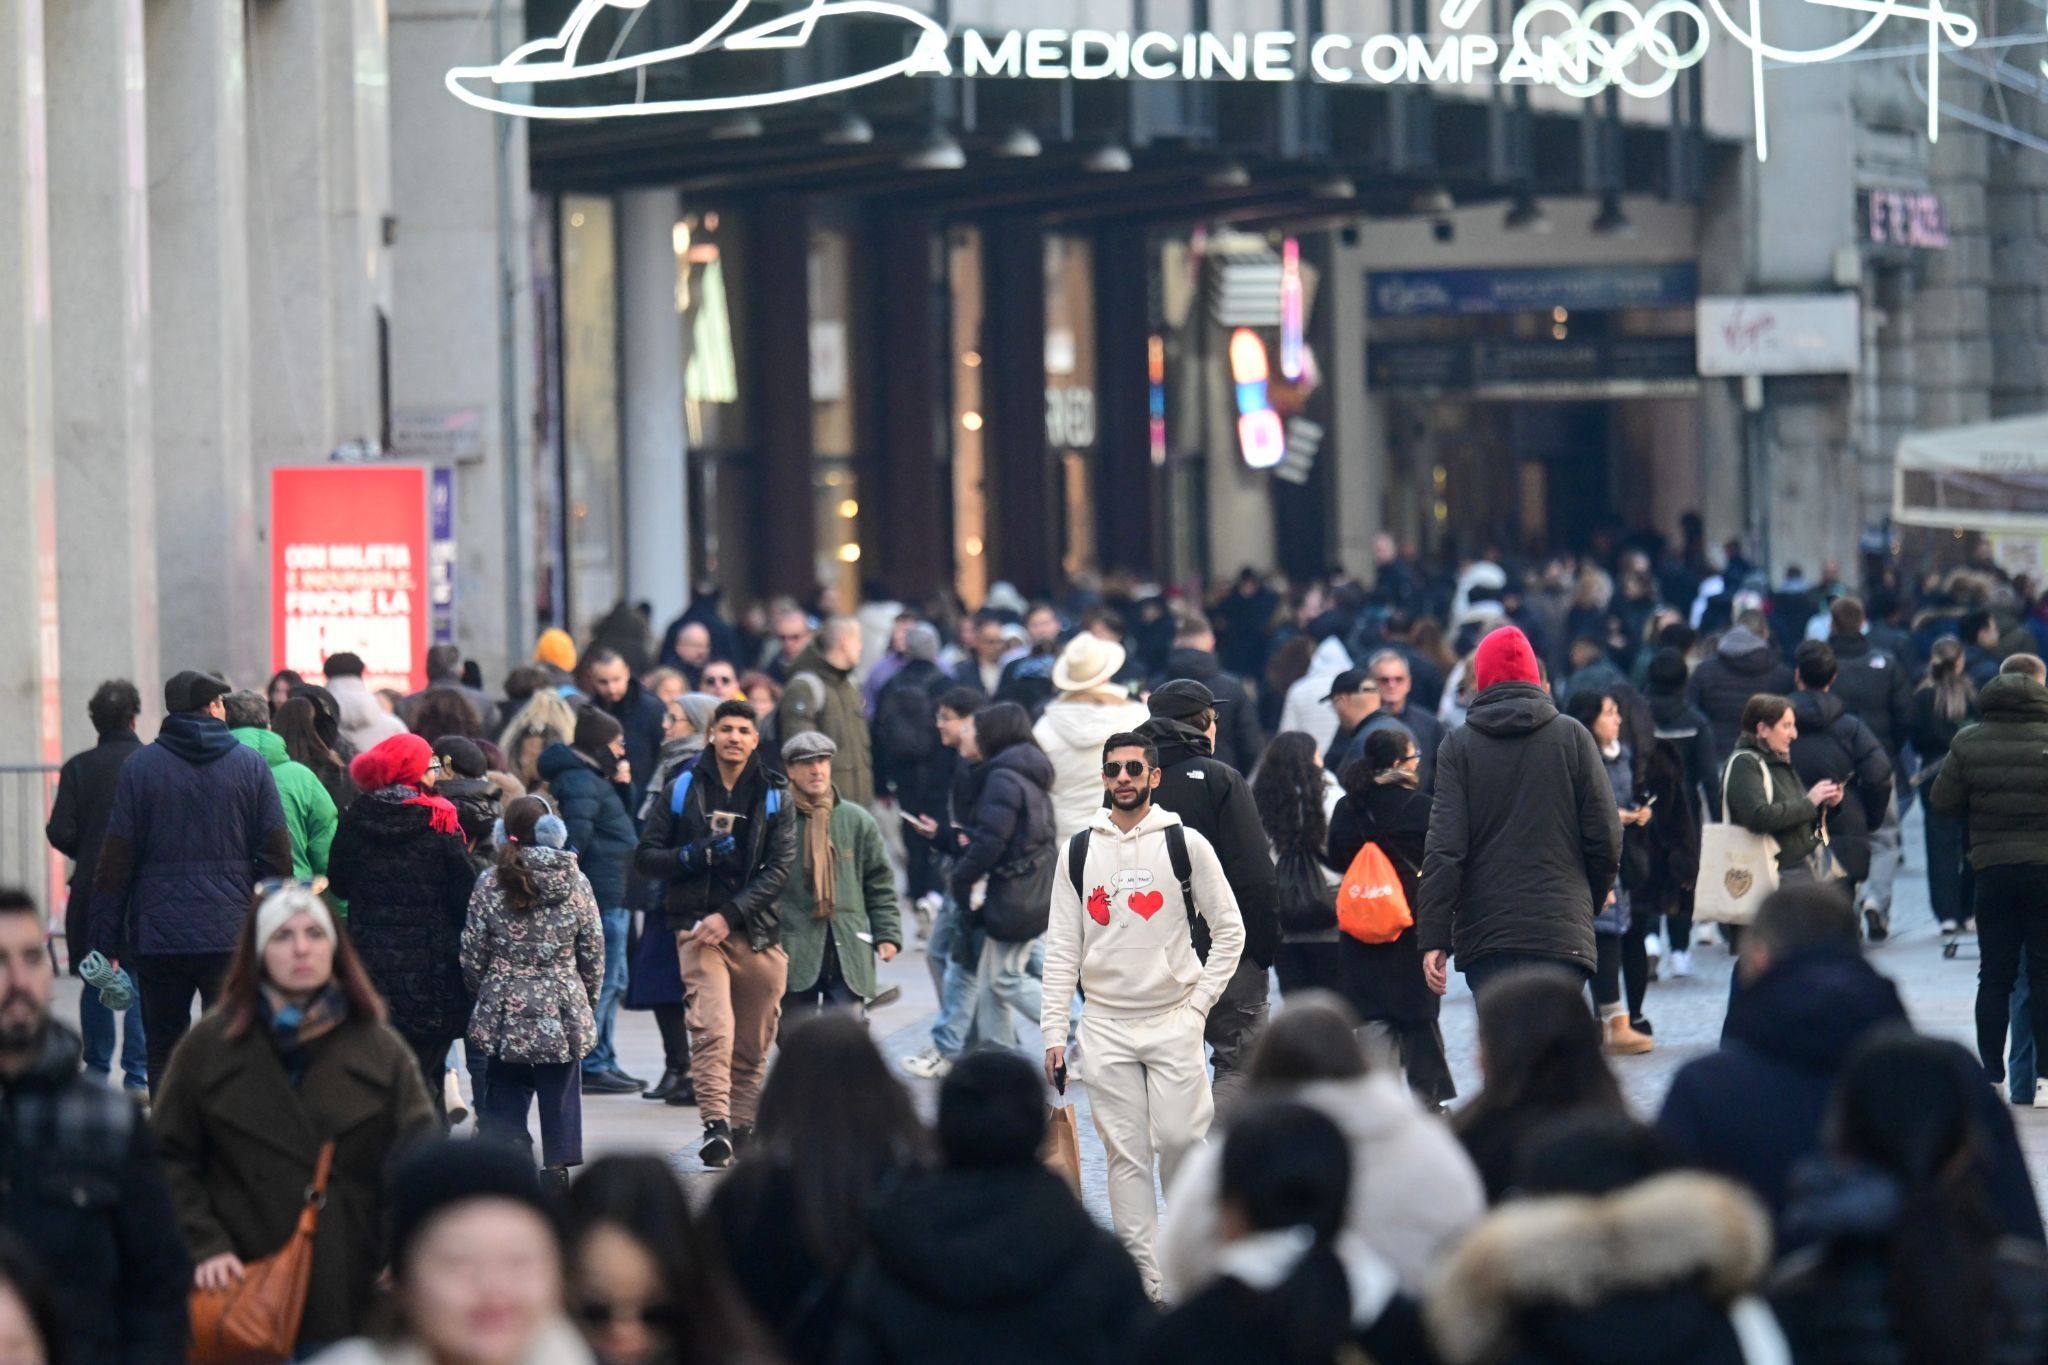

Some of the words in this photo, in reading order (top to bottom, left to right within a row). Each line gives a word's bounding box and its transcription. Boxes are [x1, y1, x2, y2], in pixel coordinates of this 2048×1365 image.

[904, 28, 953, 77] A
[963, 28, 1297, 80] MEDICINE
[1311, 34, 1642, 84] COMPANY
